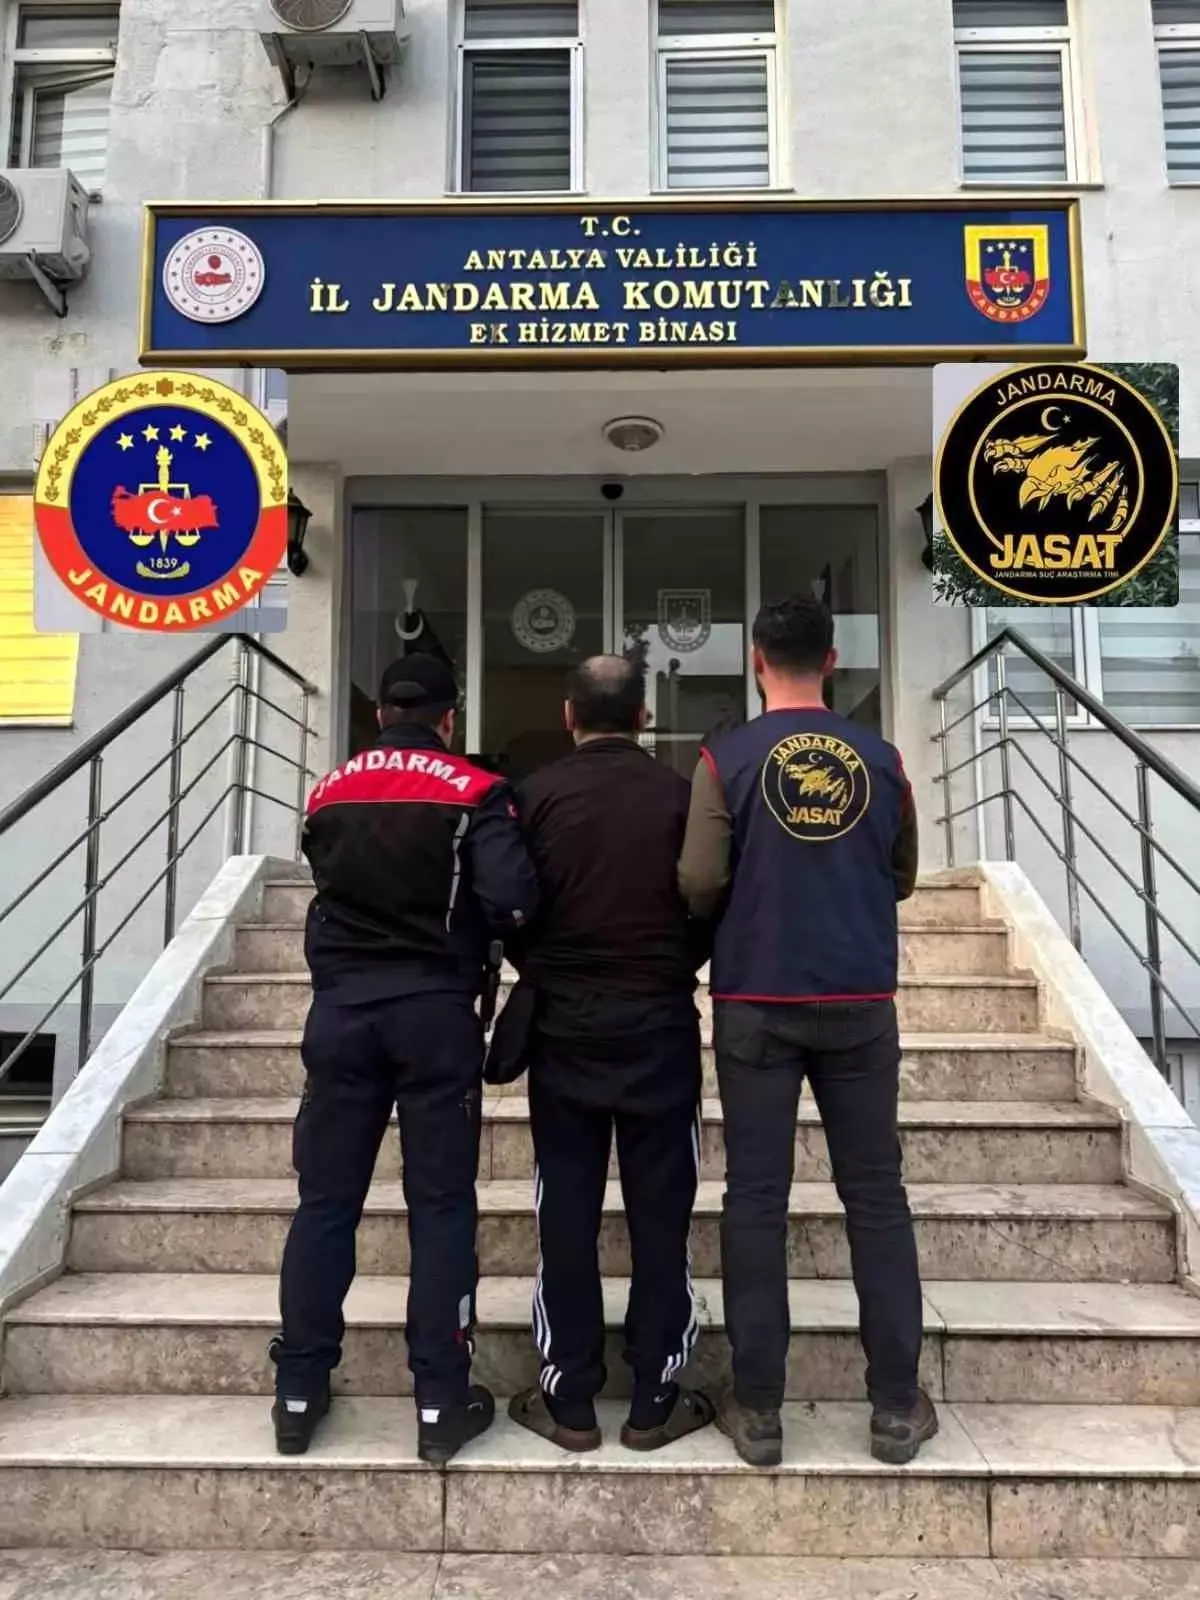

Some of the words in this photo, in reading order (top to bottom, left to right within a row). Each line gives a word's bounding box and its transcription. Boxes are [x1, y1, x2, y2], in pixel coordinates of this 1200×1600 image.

[580, 215, 641, 237] T.C.
[463, 249, 607, 270] ANTALYA
[615, 242, 758, 269] VALİLİĞİ
[309, 278, 350, 313] İL
[372, 281, 600, 312] JANDARMA
[622, 271, 912, 311] KOMUTANLIĞI
[469, 323, 508, 344] EK
[518, 317, 630, 344] HİZMET
[639, 317, 737, 343] BİNASI
[772, 736, 860, 772] JANDARMA
[314, 750, 472, 799] JANDARMA
[786, 806, 843, 826] JASAT
